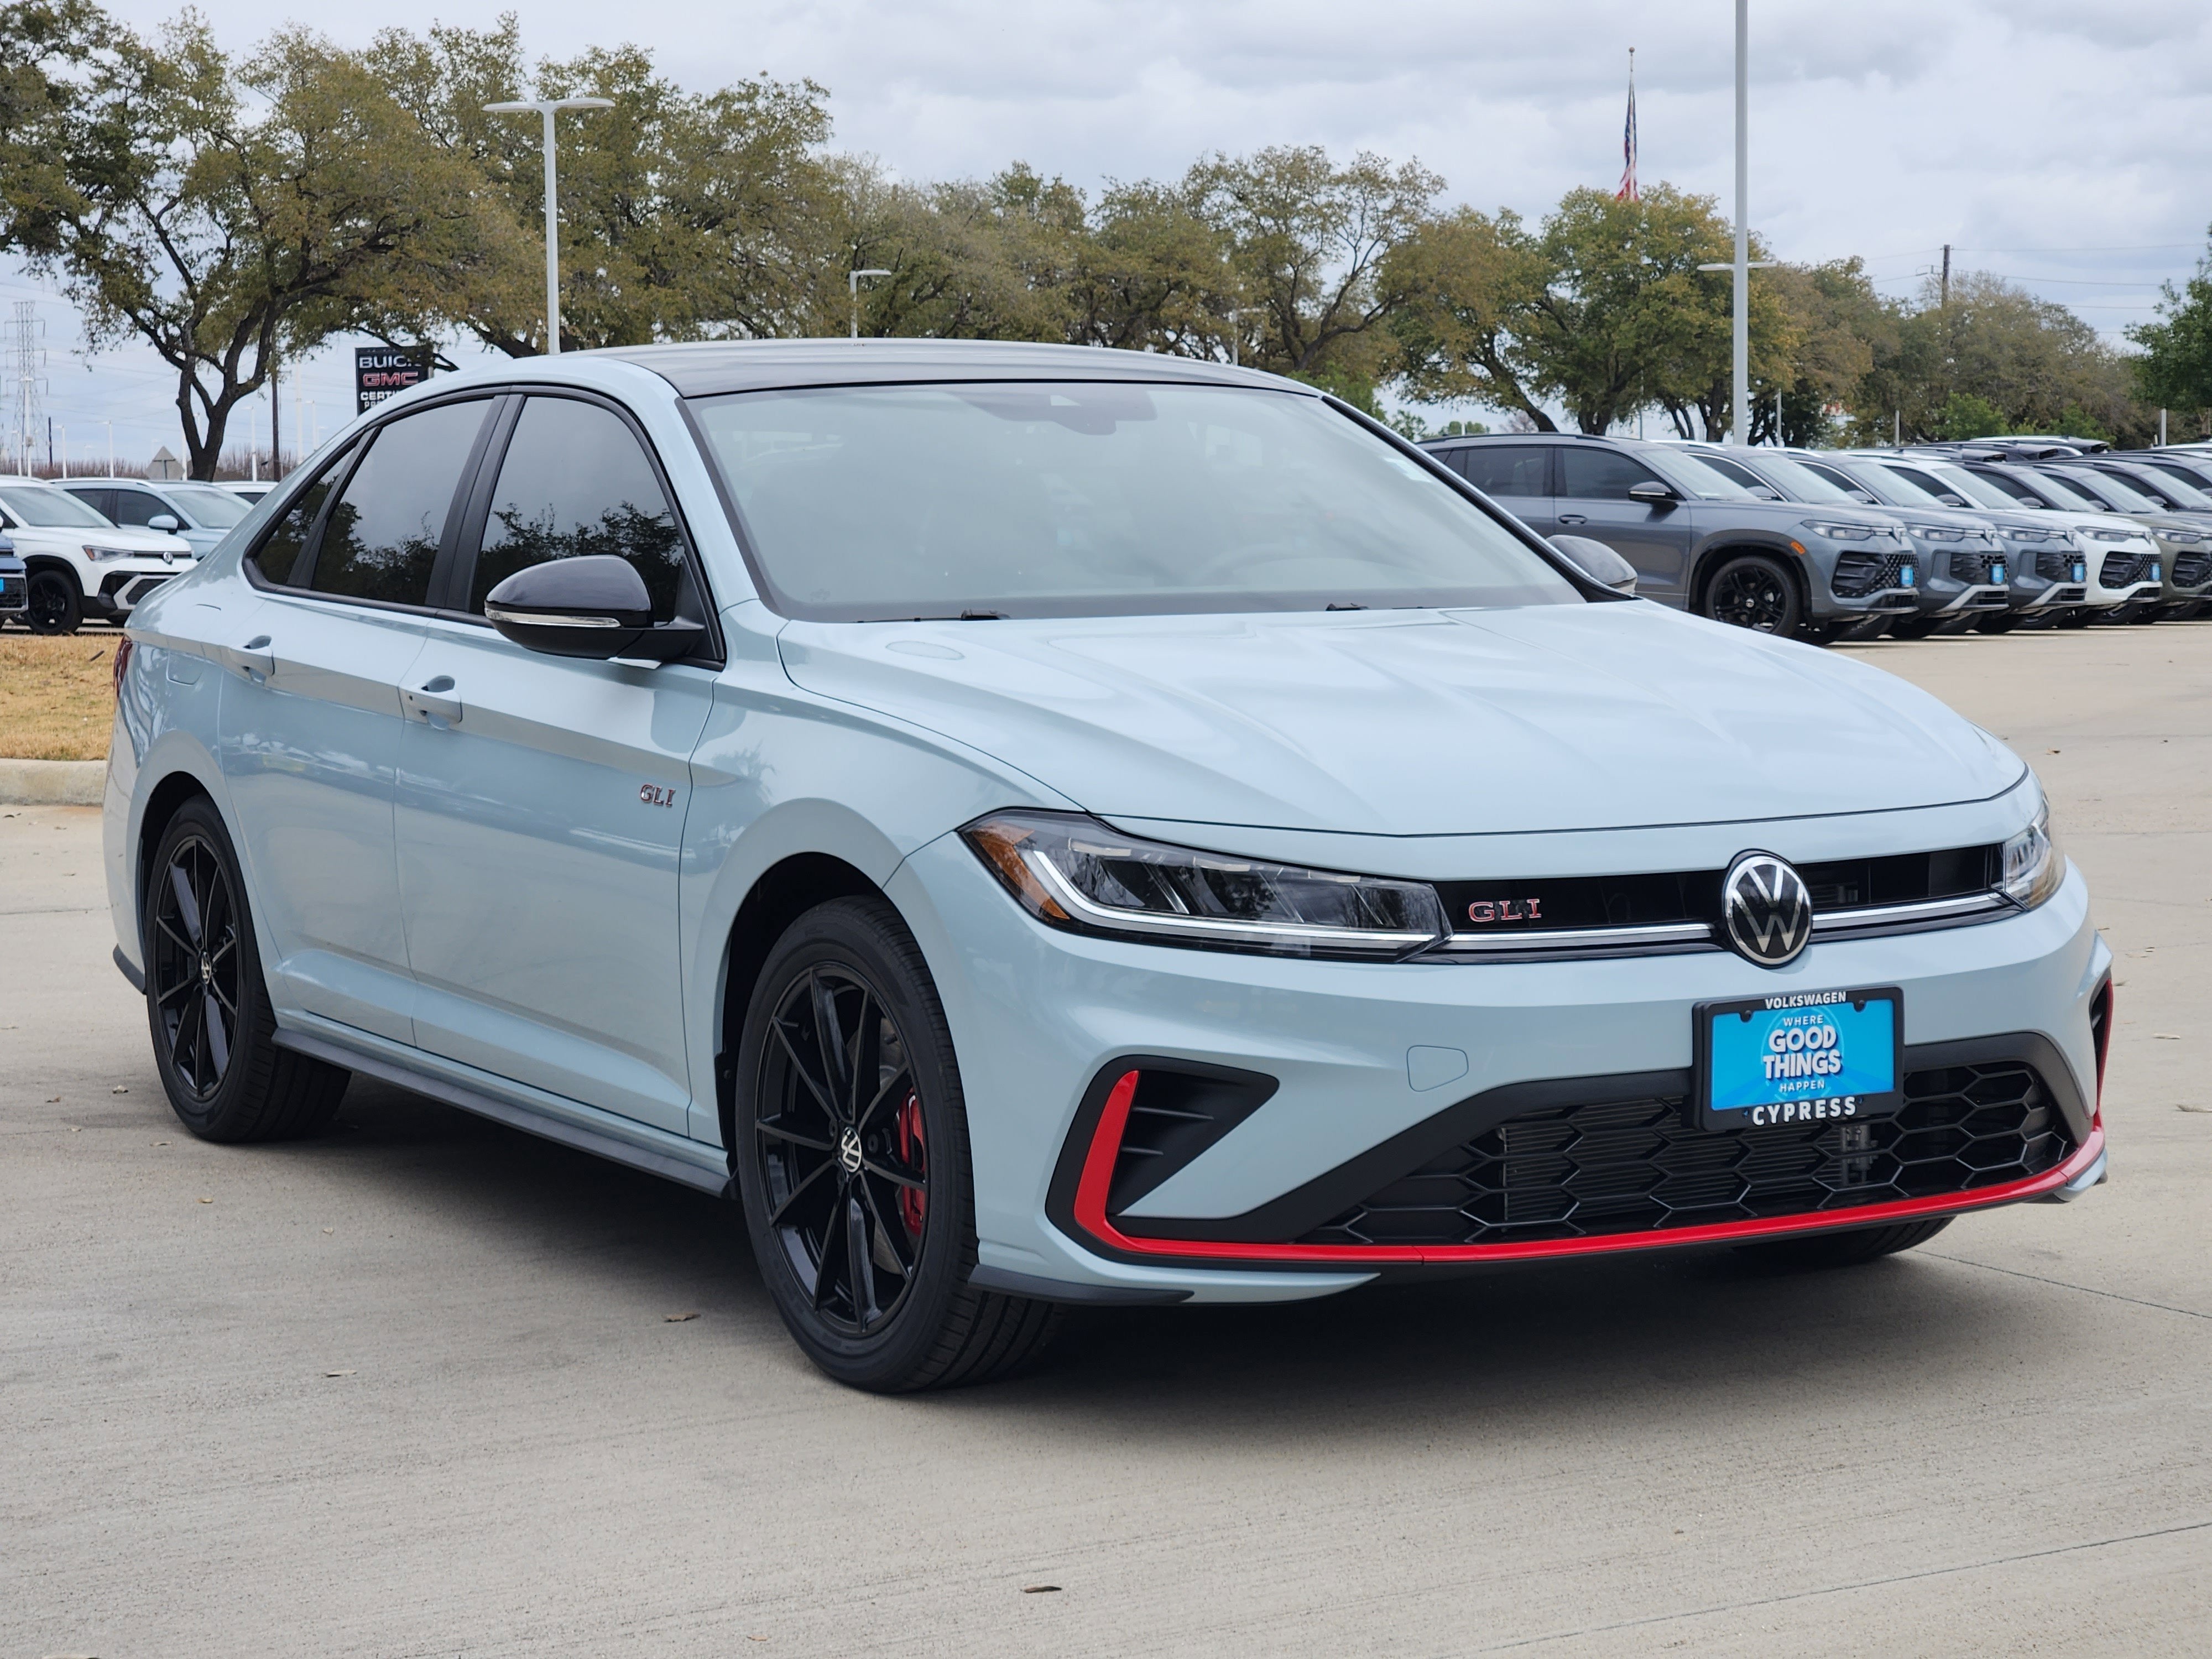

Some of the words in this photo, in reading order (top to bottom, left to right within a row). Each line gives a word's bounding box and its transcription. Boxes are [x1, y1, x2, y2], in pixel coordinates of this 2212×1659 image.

[363, 371, 419, 387] GMC
[640, 784, 676, 807] GLI
[1468, 898, 1542, 922] GLI
[1765, 991, 1846, 1009] VOLKSWAGEN
[1783, 1014, 1824, 1026] WHERE
[1768, 1025, 1837, 1053] GOOD
[1763, 1048, 1842, 1079] THINGS
[1779, 1079, 1825, 1093] HAPPEN
[1752, 1096, 1856, 1126] CYPRESS
